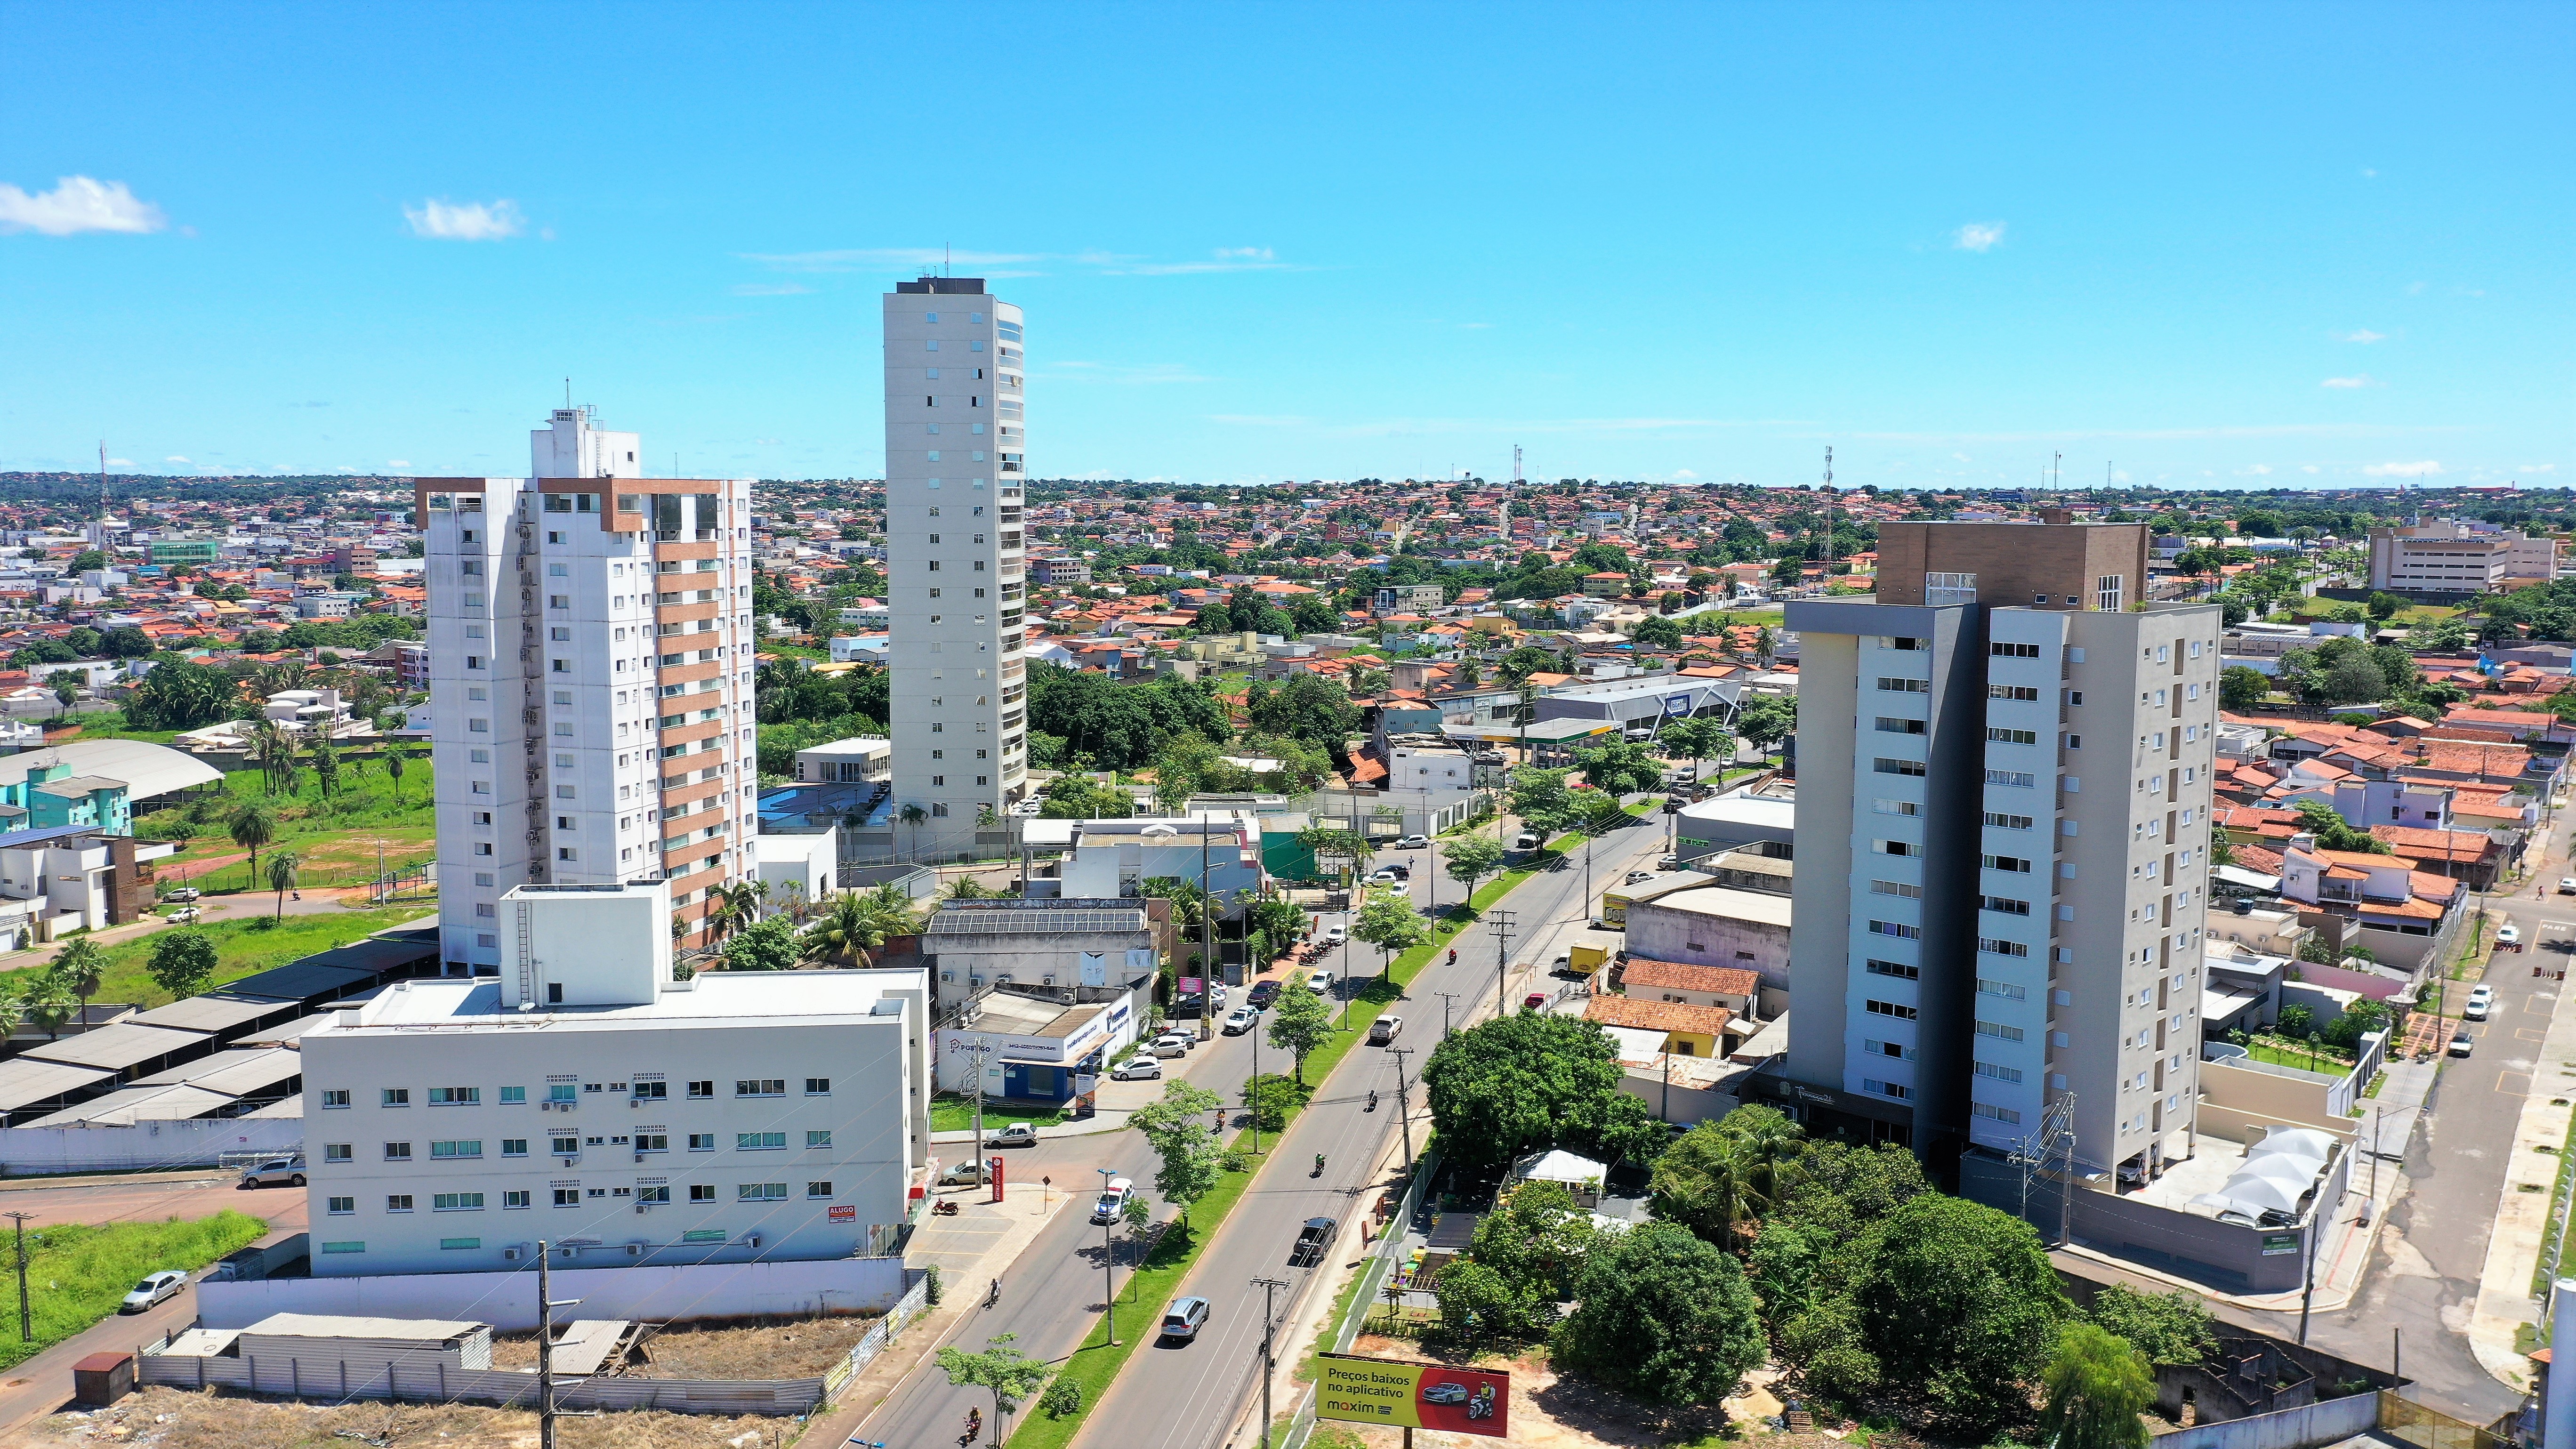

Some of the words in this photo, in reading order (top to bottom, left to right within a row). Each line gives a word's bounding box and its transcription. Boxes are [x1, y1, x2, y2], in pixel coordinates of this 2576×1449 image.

[961, 1045, 990, 1053] POSTGO
[1328, 1368, 1368, 1382] Preços
[1371, 1372, 1409, 1385] baixos
[1328, 1382, 1343, 1392] no
[1346, 1384, 1403, 1398] aplicativo
[1328, 1400, 1374, 1413] maxim
